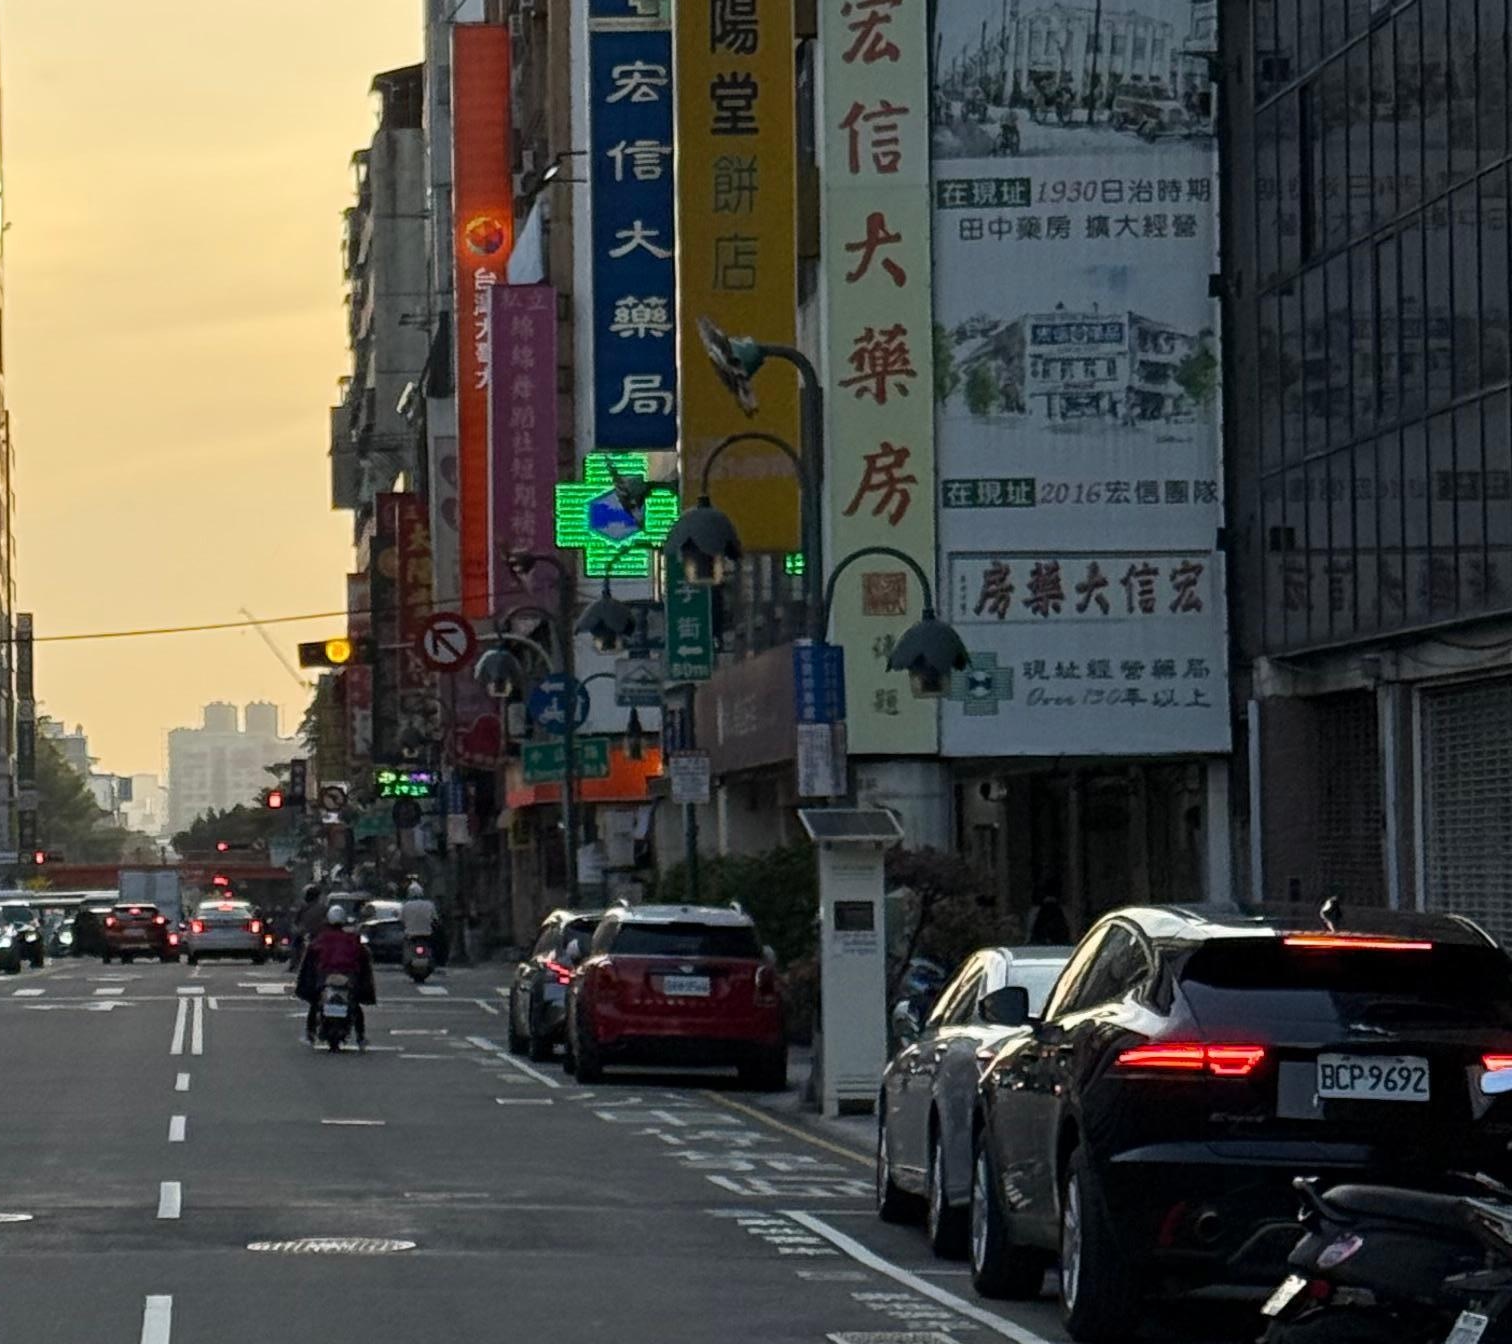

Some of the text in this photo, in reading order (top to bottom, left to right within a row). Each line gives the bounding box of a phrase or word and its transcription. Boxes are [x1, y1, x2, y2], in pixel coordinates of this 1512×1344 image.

[605, 59, 673, 417] 宏信大藥局
